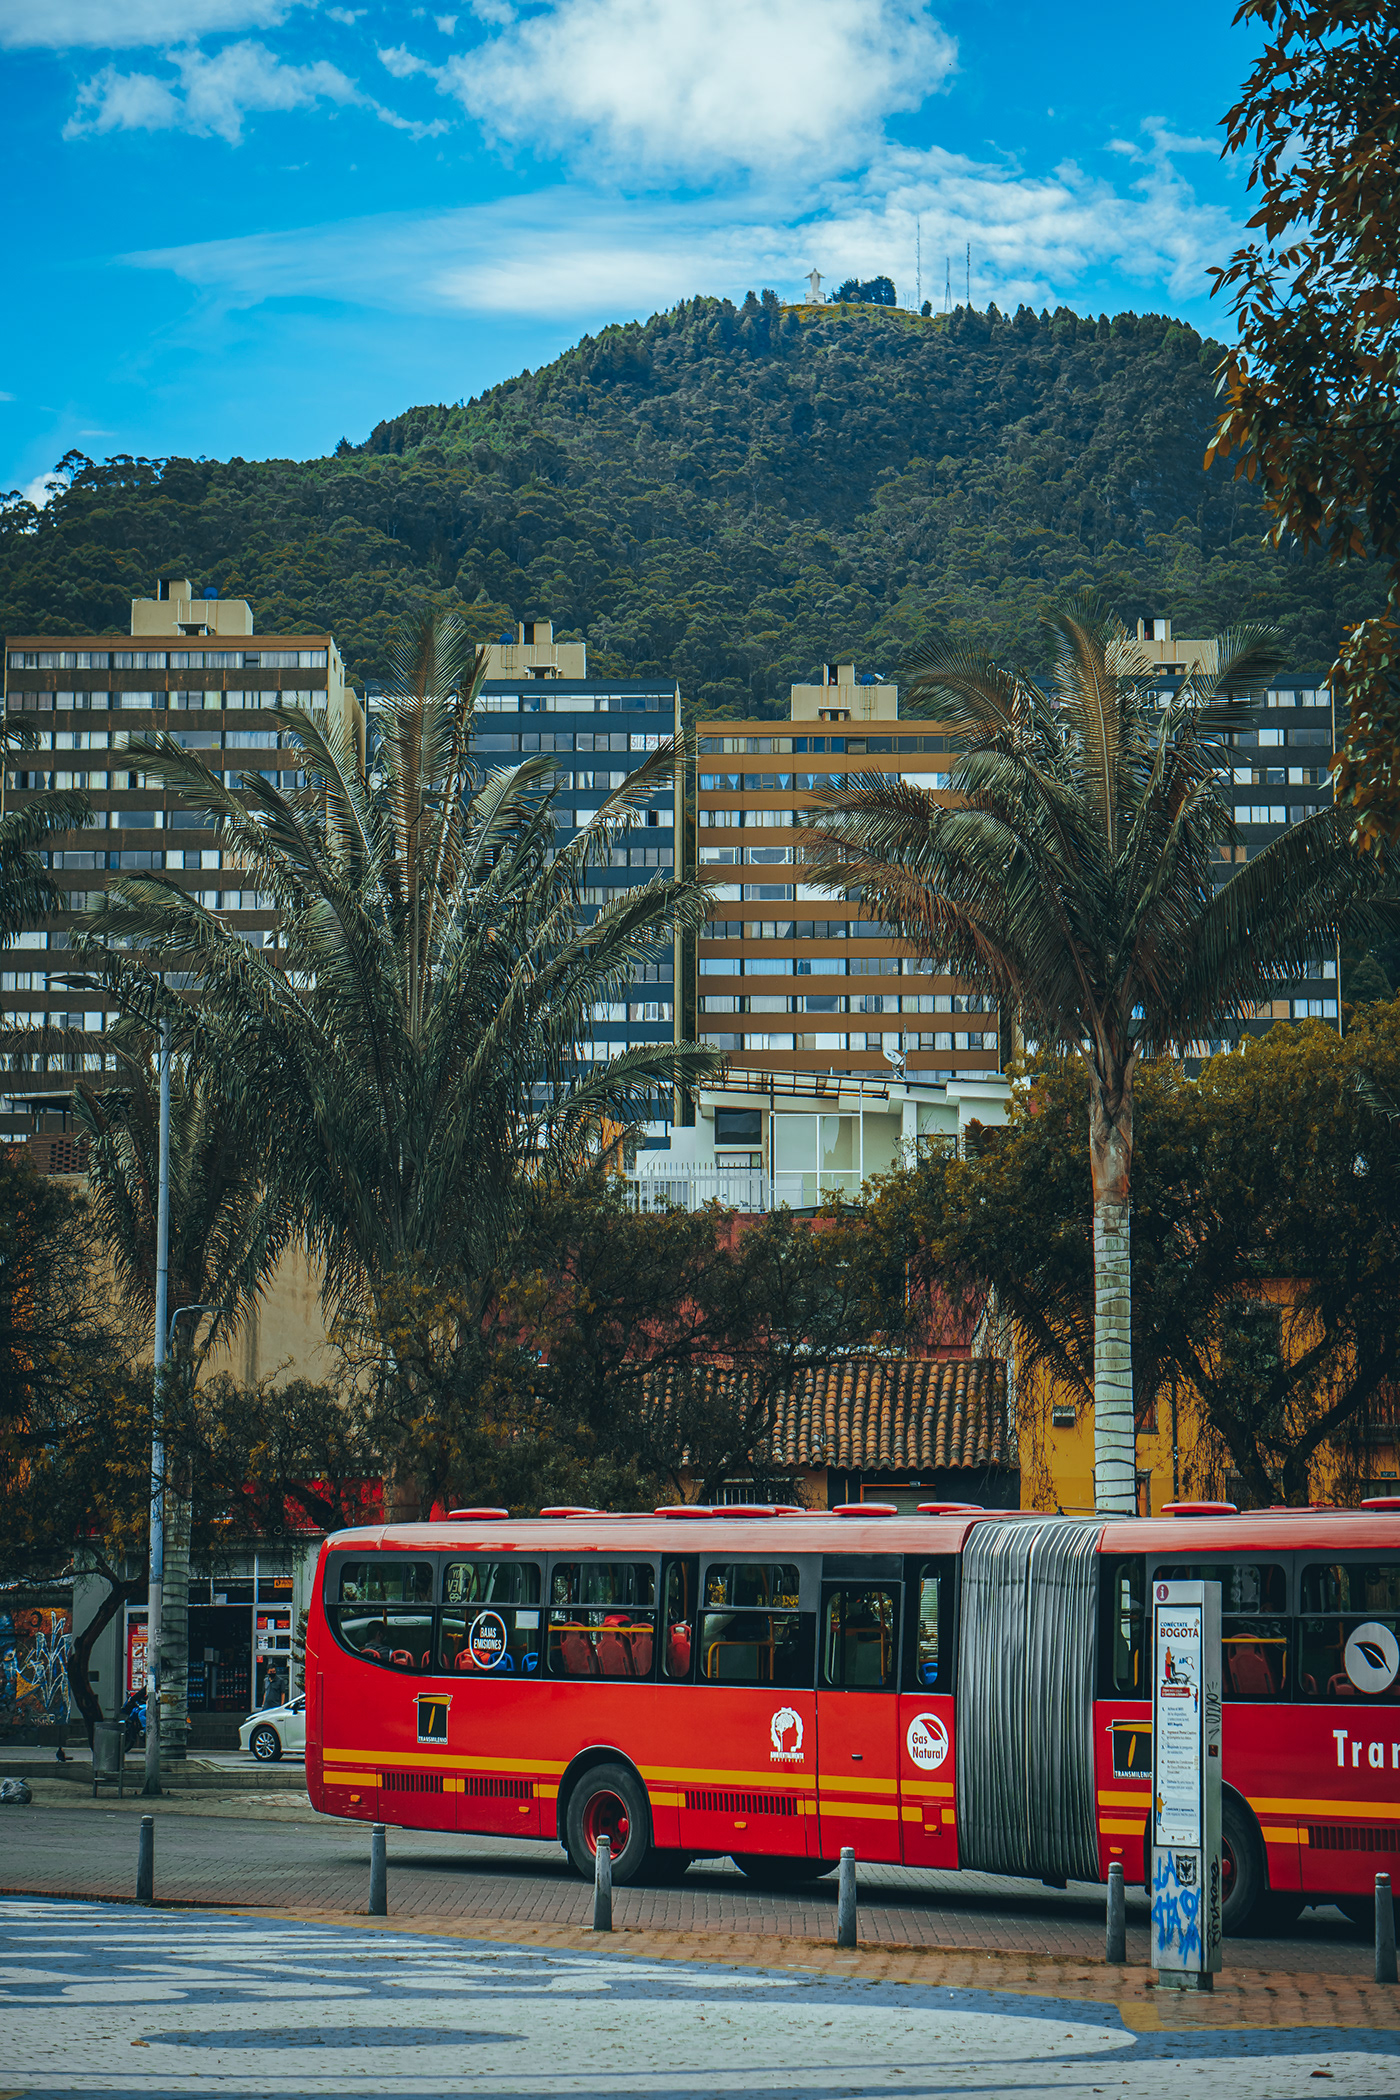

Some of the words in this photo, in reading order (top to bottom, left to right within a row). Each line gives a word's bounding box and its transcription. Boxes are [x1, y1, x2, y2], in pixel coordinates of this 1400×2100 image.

[480, 1627, 497, 1638] BAJAS
[474, 1638, 502, 1650] EMISIONES
[912, 1732, 928, 1744] Gas
[912, 1746, 943, 1759] Natural
